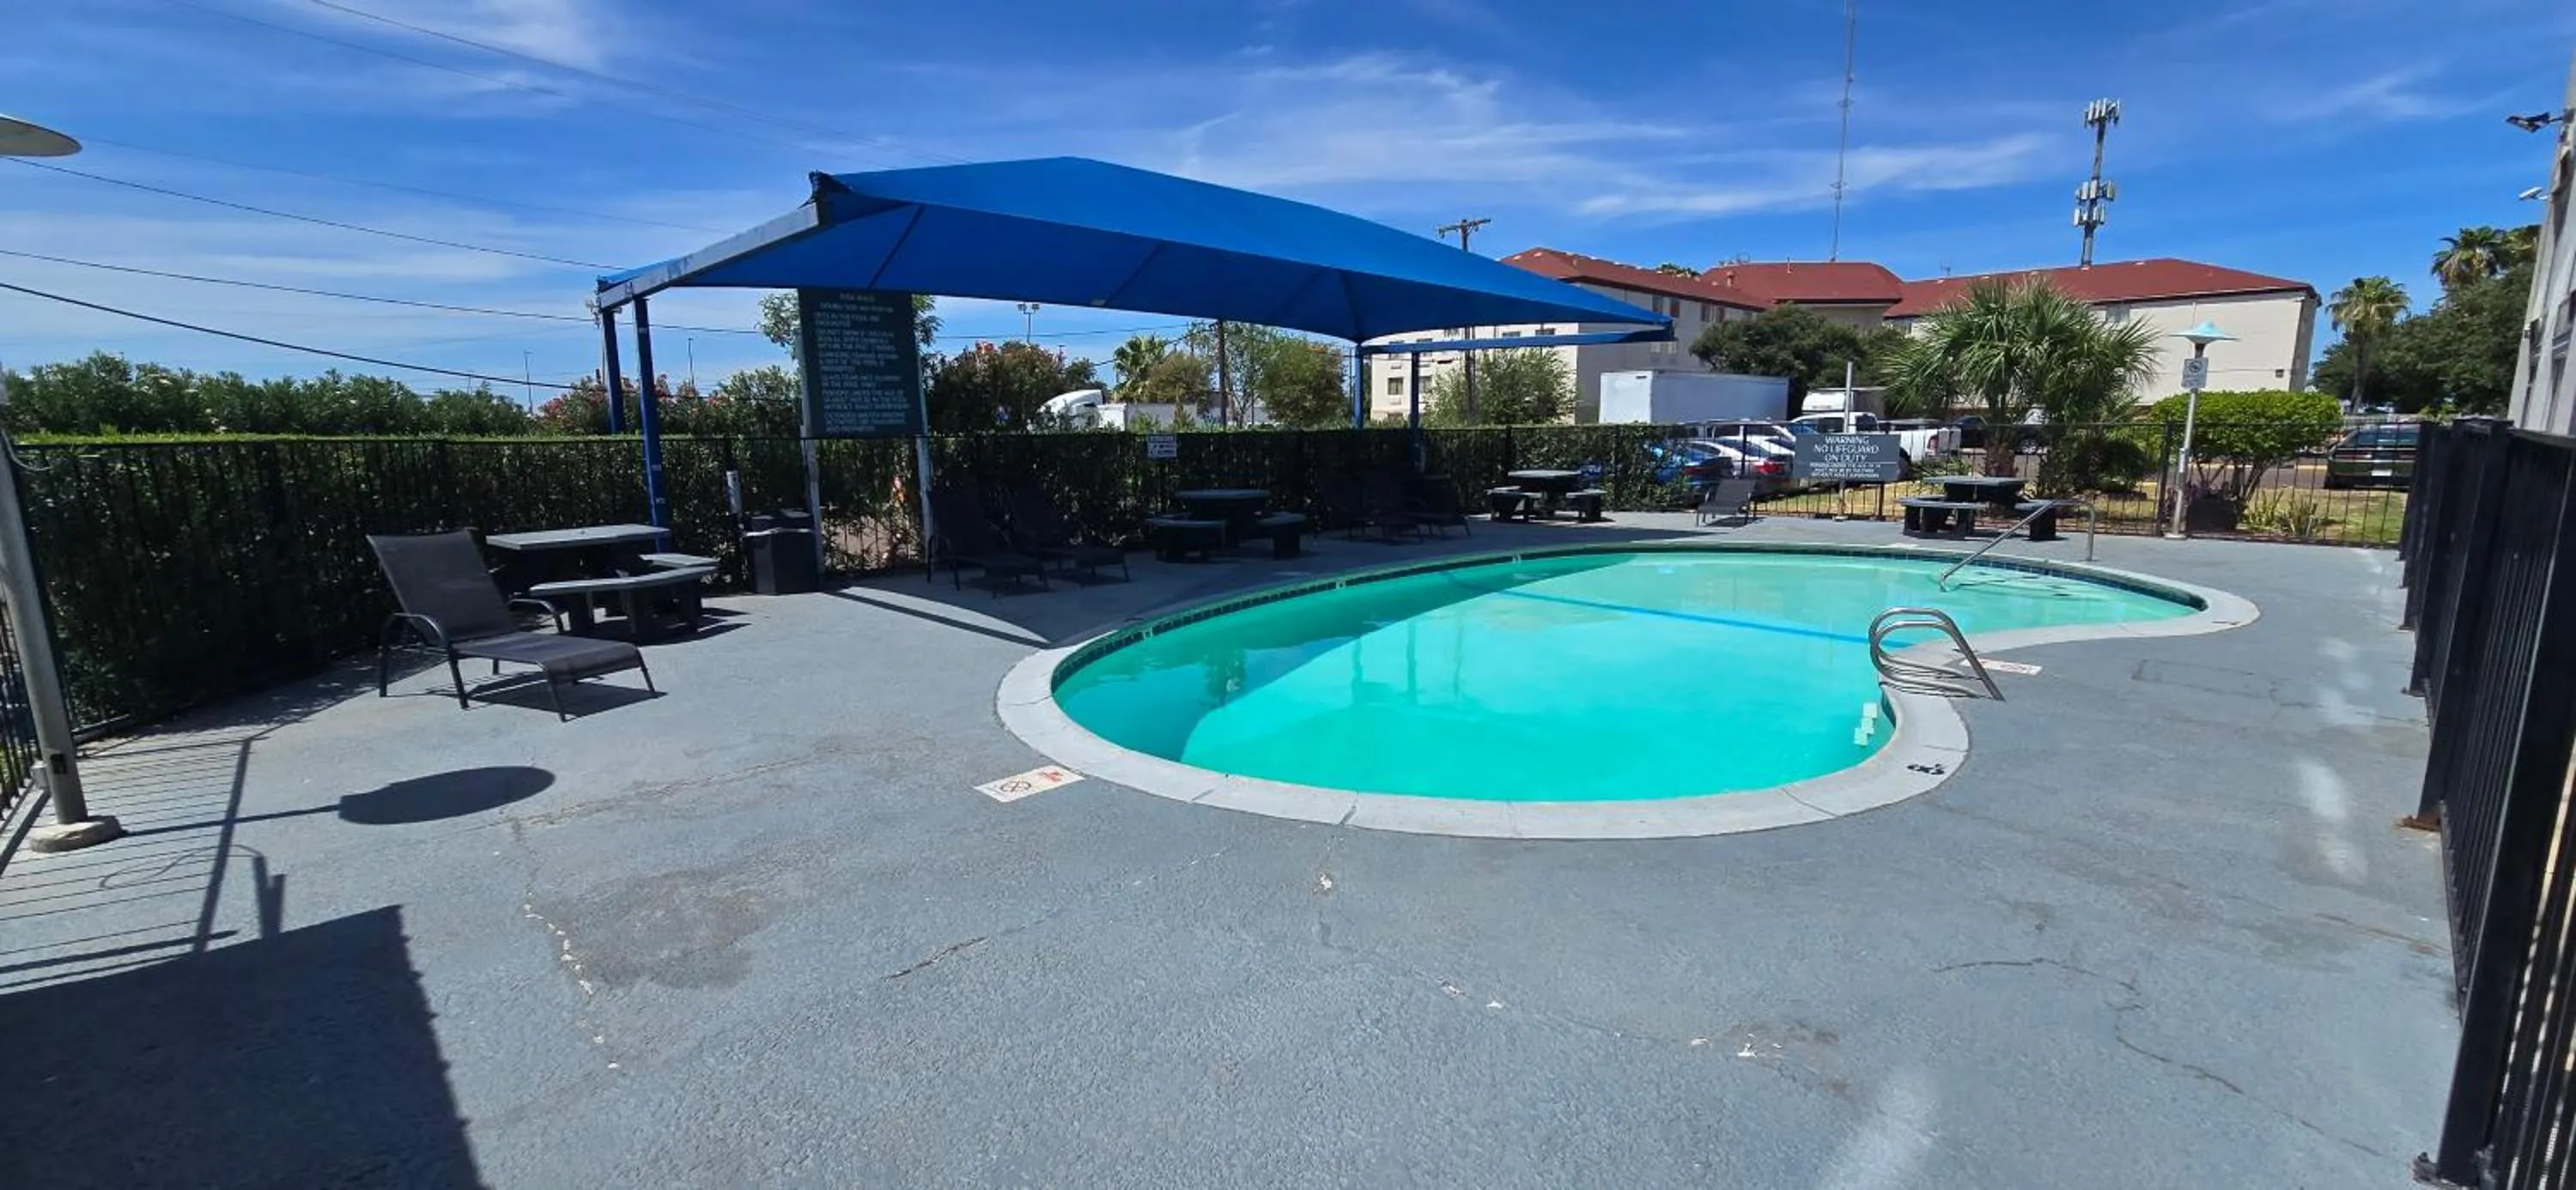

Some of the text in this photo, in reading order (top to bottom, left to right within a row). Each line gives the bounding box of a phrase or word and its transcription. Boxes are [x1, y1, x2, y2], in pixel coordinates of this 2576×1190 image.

[1825, 435, 1869, 444] WARNING
[1813, 444, 1880, 454] NO LIFEGUARD
[1825, 453, 1838, 462] ON
